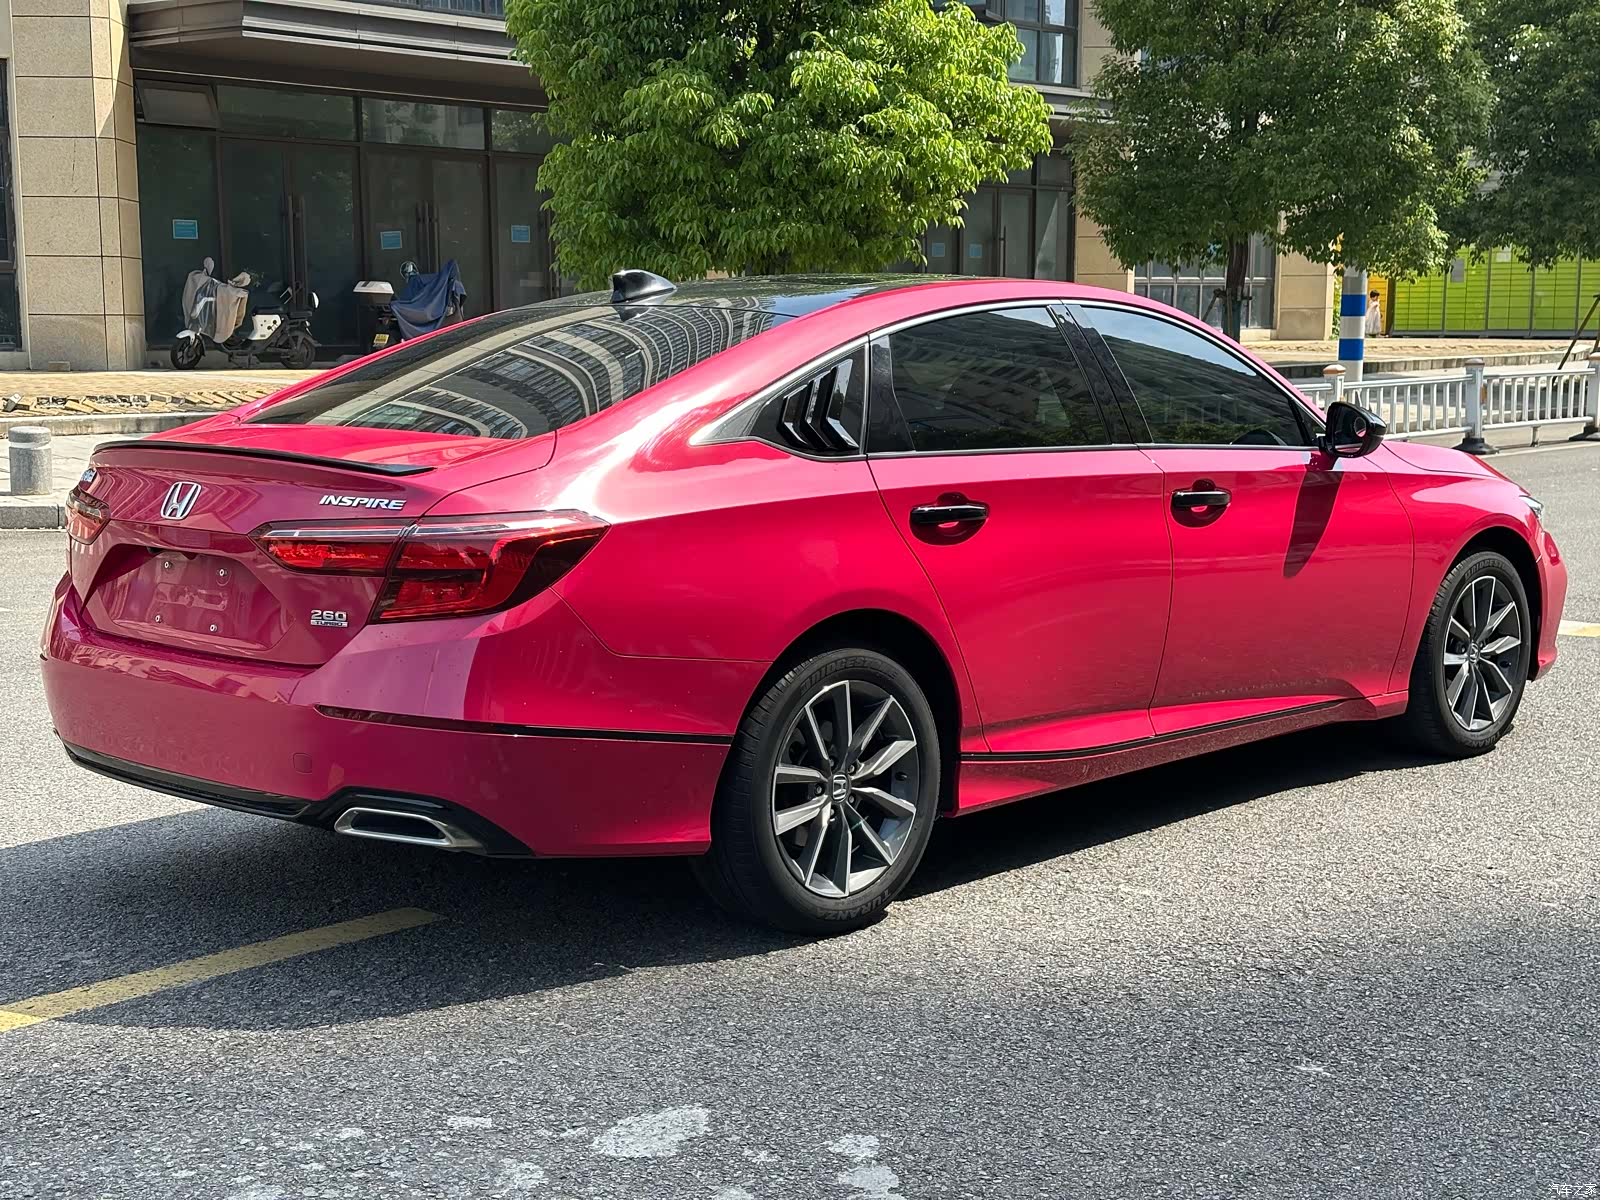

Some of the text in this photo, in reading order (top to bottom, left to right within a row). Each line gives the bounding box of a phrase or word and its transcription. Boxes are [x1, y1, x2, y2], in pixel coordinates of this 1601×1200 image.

[319, 495, 406, 510] INSPIRE
[311, 609, 347, 620] 260
[815, 888, 891, 920] TURANZA
